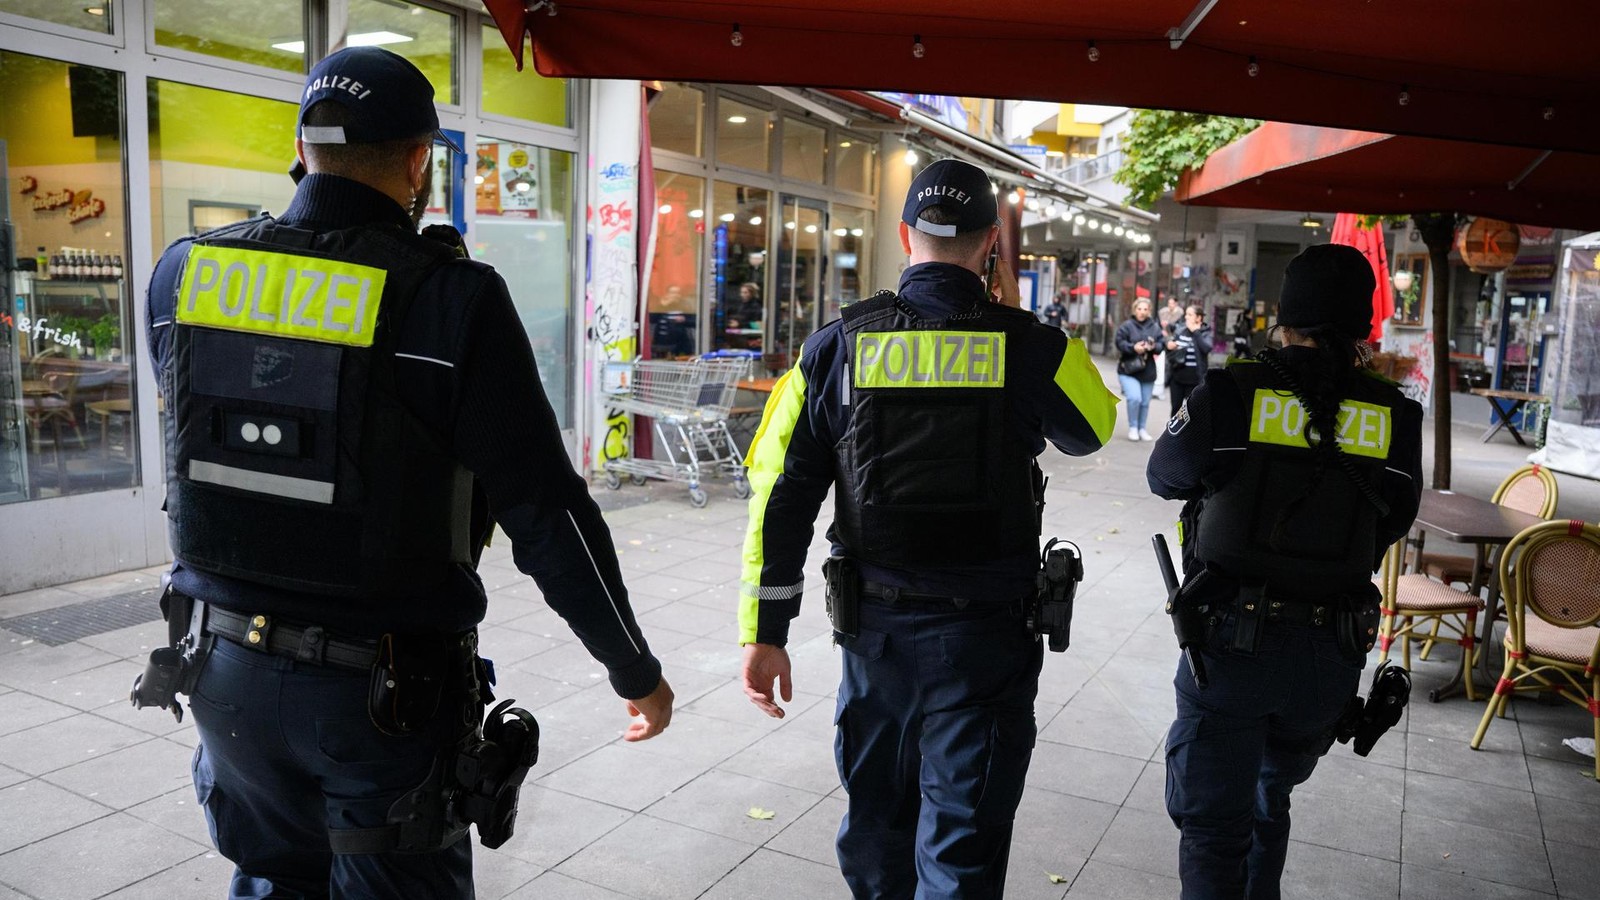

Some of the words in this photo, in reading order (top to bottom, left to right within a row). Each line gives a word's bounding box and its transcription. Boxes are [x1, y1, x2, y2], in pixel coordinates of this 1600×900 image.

[306, 75, 371, 100] POLIZEI
[917, 185, 971, 205] POLIZEI
[1483, 229, 1502, 257] K
[186, 258, 371, 335] POLIZEI
[17, 317, 32, 334] &
[33, 318, 82, 350] frish
[859, 335, 1000, 383] POLIZEI
[1257, 396, 1387, 450] POZEI
